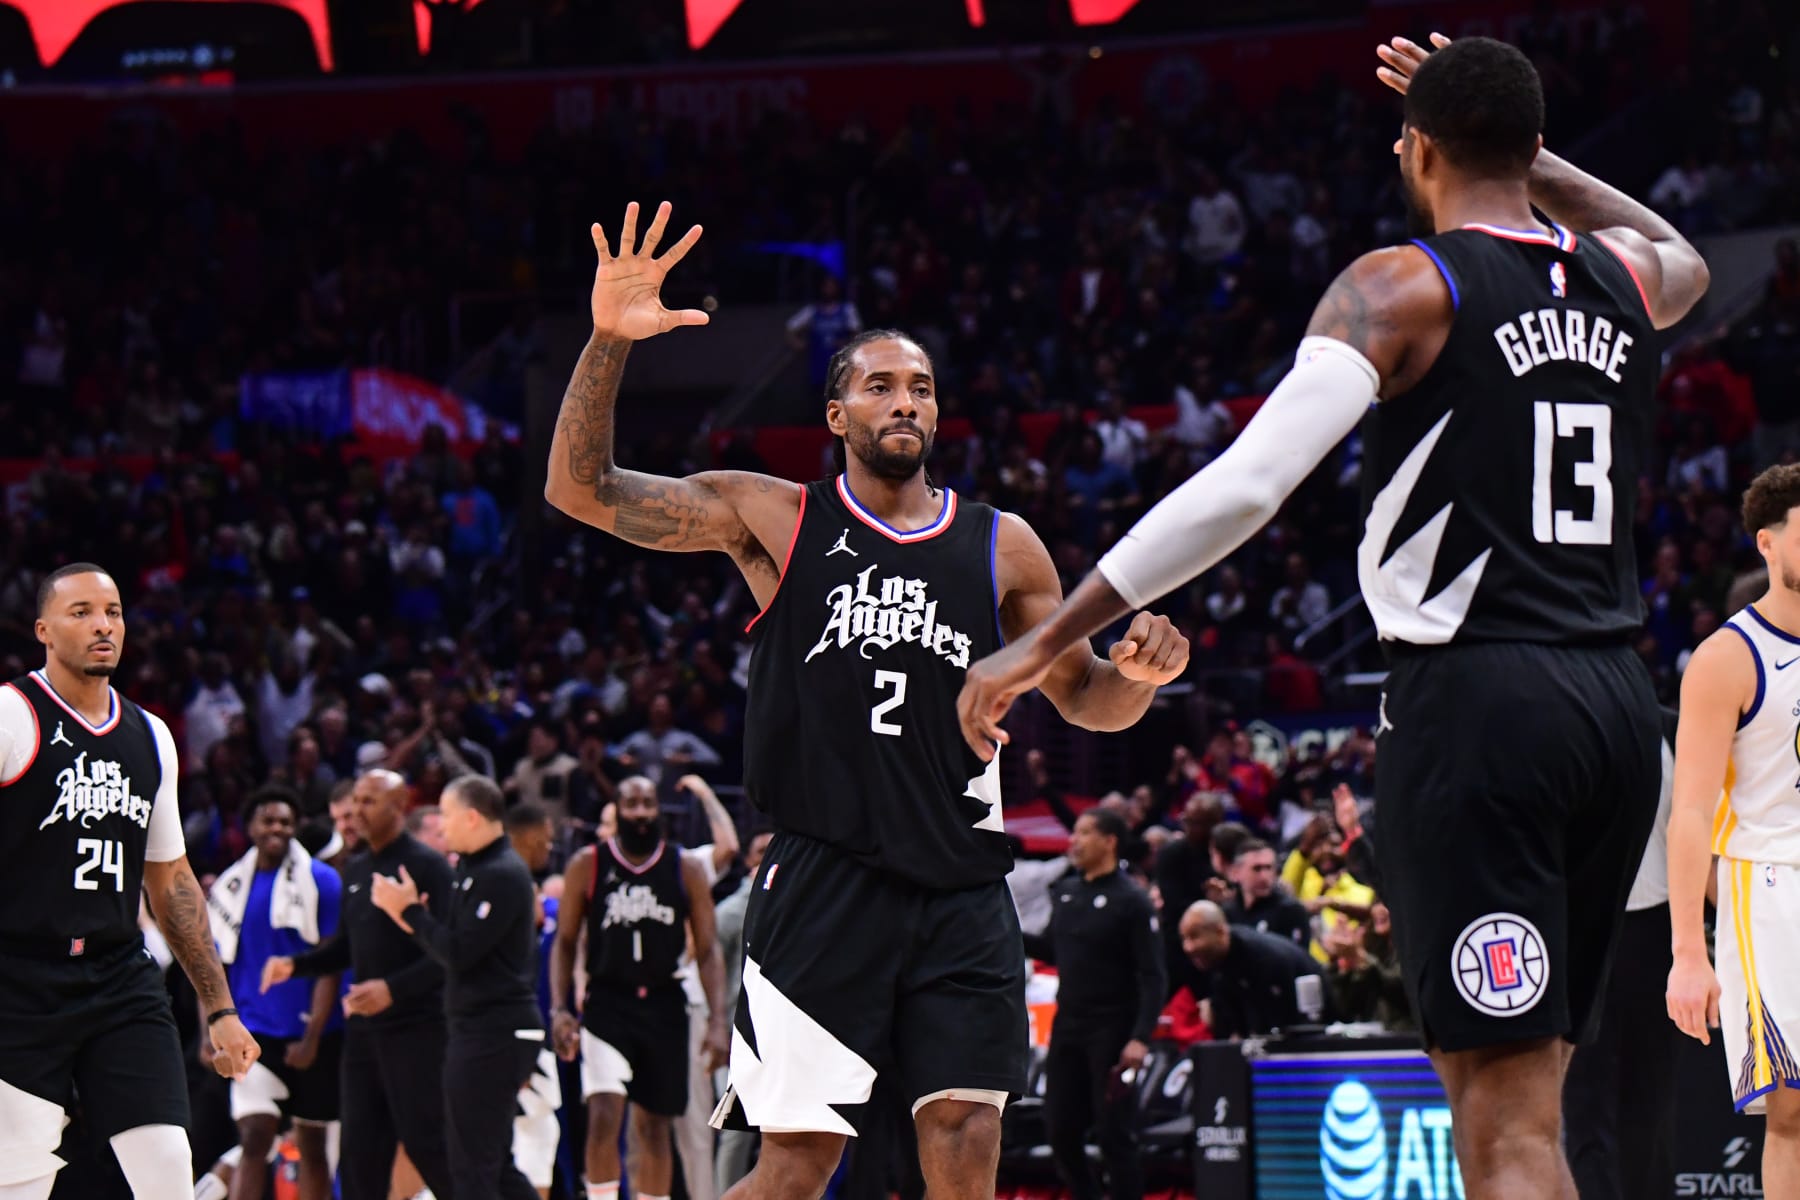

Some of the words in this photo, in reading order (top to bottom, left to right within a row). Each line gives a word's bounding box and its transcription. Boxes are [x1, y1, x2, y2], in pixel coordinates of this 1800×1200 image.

[1494, 308, 1633, 383] GEORGE
[1532, 401, 1613, 545] 13
[851, 564, 928, 612] Los
[804, 584, 972, 669] Angeles
[871, 669, 907, 736] 2
[39, 768, 151, 831] Angeles
[73, 751, 121, 788] Los
[74, 838, 124, 892] 24
[633, 930, 643, 962] 1
[1393, 1107, 1466, 1200] AT
[1674, 1172, 1763, 1197] STARL
